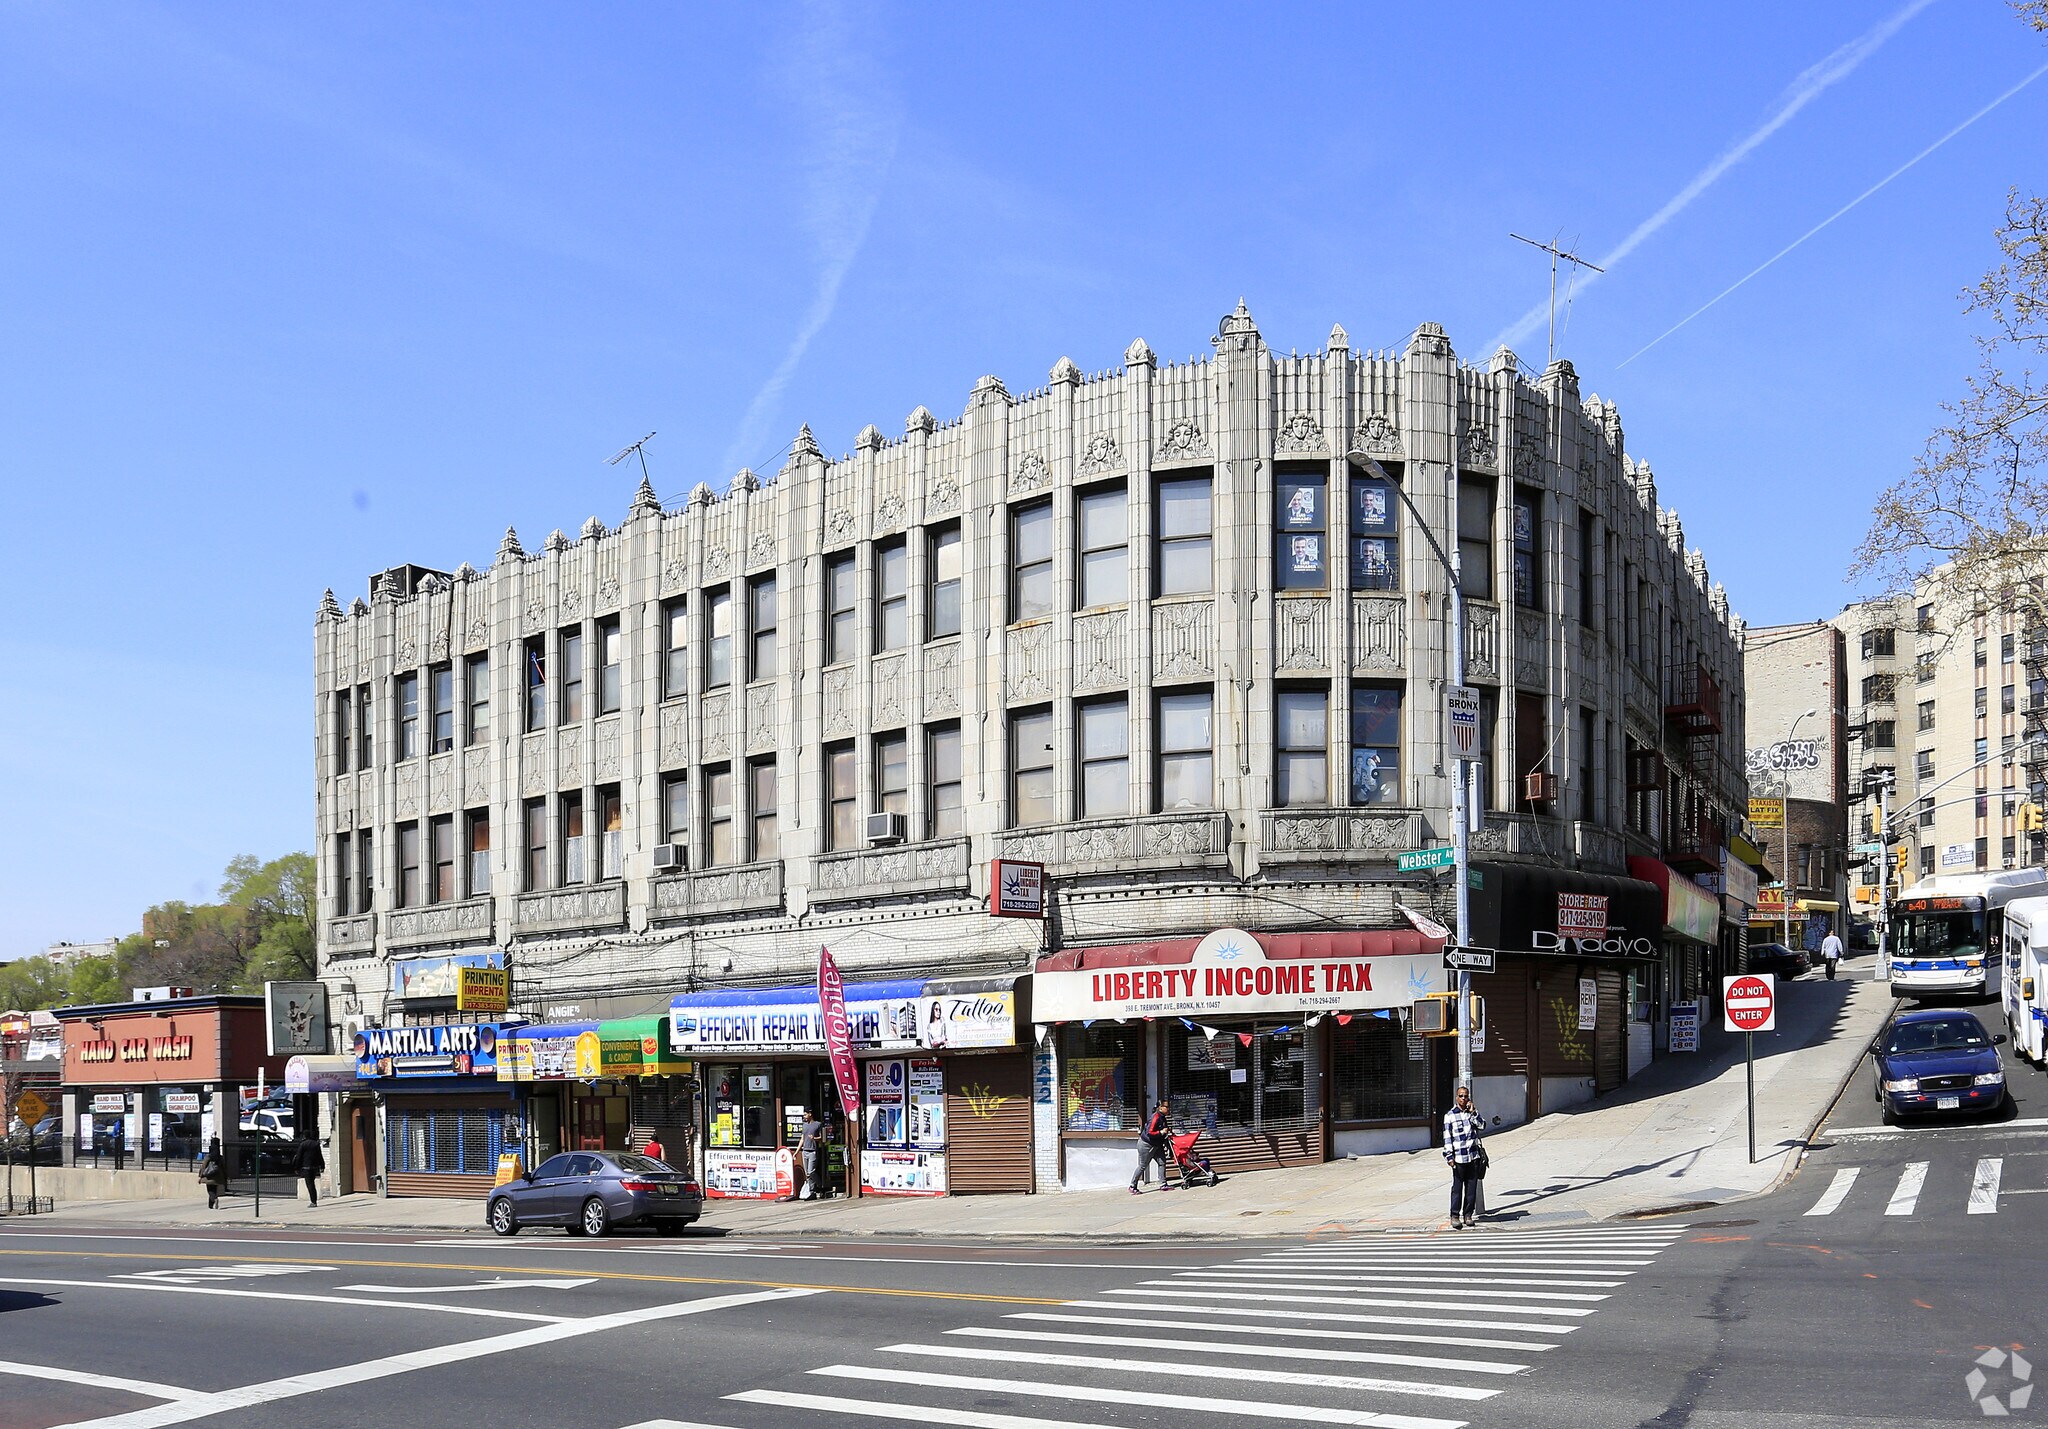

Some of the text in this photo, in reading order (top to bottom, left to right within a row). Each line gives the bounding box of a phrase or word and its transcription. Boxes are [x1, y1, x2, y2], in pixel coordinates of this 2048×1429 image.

[1449, 698, 1479, 711] BRONX
[1400, 852, 1442, 869] Webster
[1020, 868, 1039, 878] LIBERTY
[1020, 878, 1039, 888] INCOME
[1020, 888, 1030, 897] TAX
[1558, 893, 1585, 909] STORE
[1588, 896, 1607, 909] RENT
[1560, 909, 1605, 927] 917-225-9199
[1451, 953, 1489, 965] ONE WAY
[464, 971, 504, 986] PRINTING
[1092, 963, 1373, 1002] LIBERTY INCOME TAX
[464, 985, 504, 997] IMPRENTA
[1732, 986, 1764, 996] DO NOT
[1299, 997, 1341, 1005] Tel. 718-294-2667
[1580, 993, 1596, 1005] RENT
[946, 998, 1004, 1022] Tattoo
[1140, 1003, 1164, 1011] TREMONT
[1176, 1002, 1195, 1010] BRONX,
[823, 971, 852, 1057] Mobile
[1735, 1010, 1763, 1020] ENTER
[700, 1012, 757, 1042] EFFICIENT
[762, 1011, 809, 1041] REPAIR
[369, 1026, 478, 1055] MARTIAL ARTS
[602, 1041, 639, 1051] CONVENIENCE
[80, 1039, 115, 1063] HAND
[120, 1038, 148, 1061] CAR
[152, 1035, 192, 1061] WASH
[498, 1044, 530, 1054] PRINTING
[613, 1053, 633, 1062] CANDY
[869, 1063, 884, 1075] NO
[1036, 1053, 1054, 1105] TAT2
[709, 1152, 773, 1163] Efficient Repair
